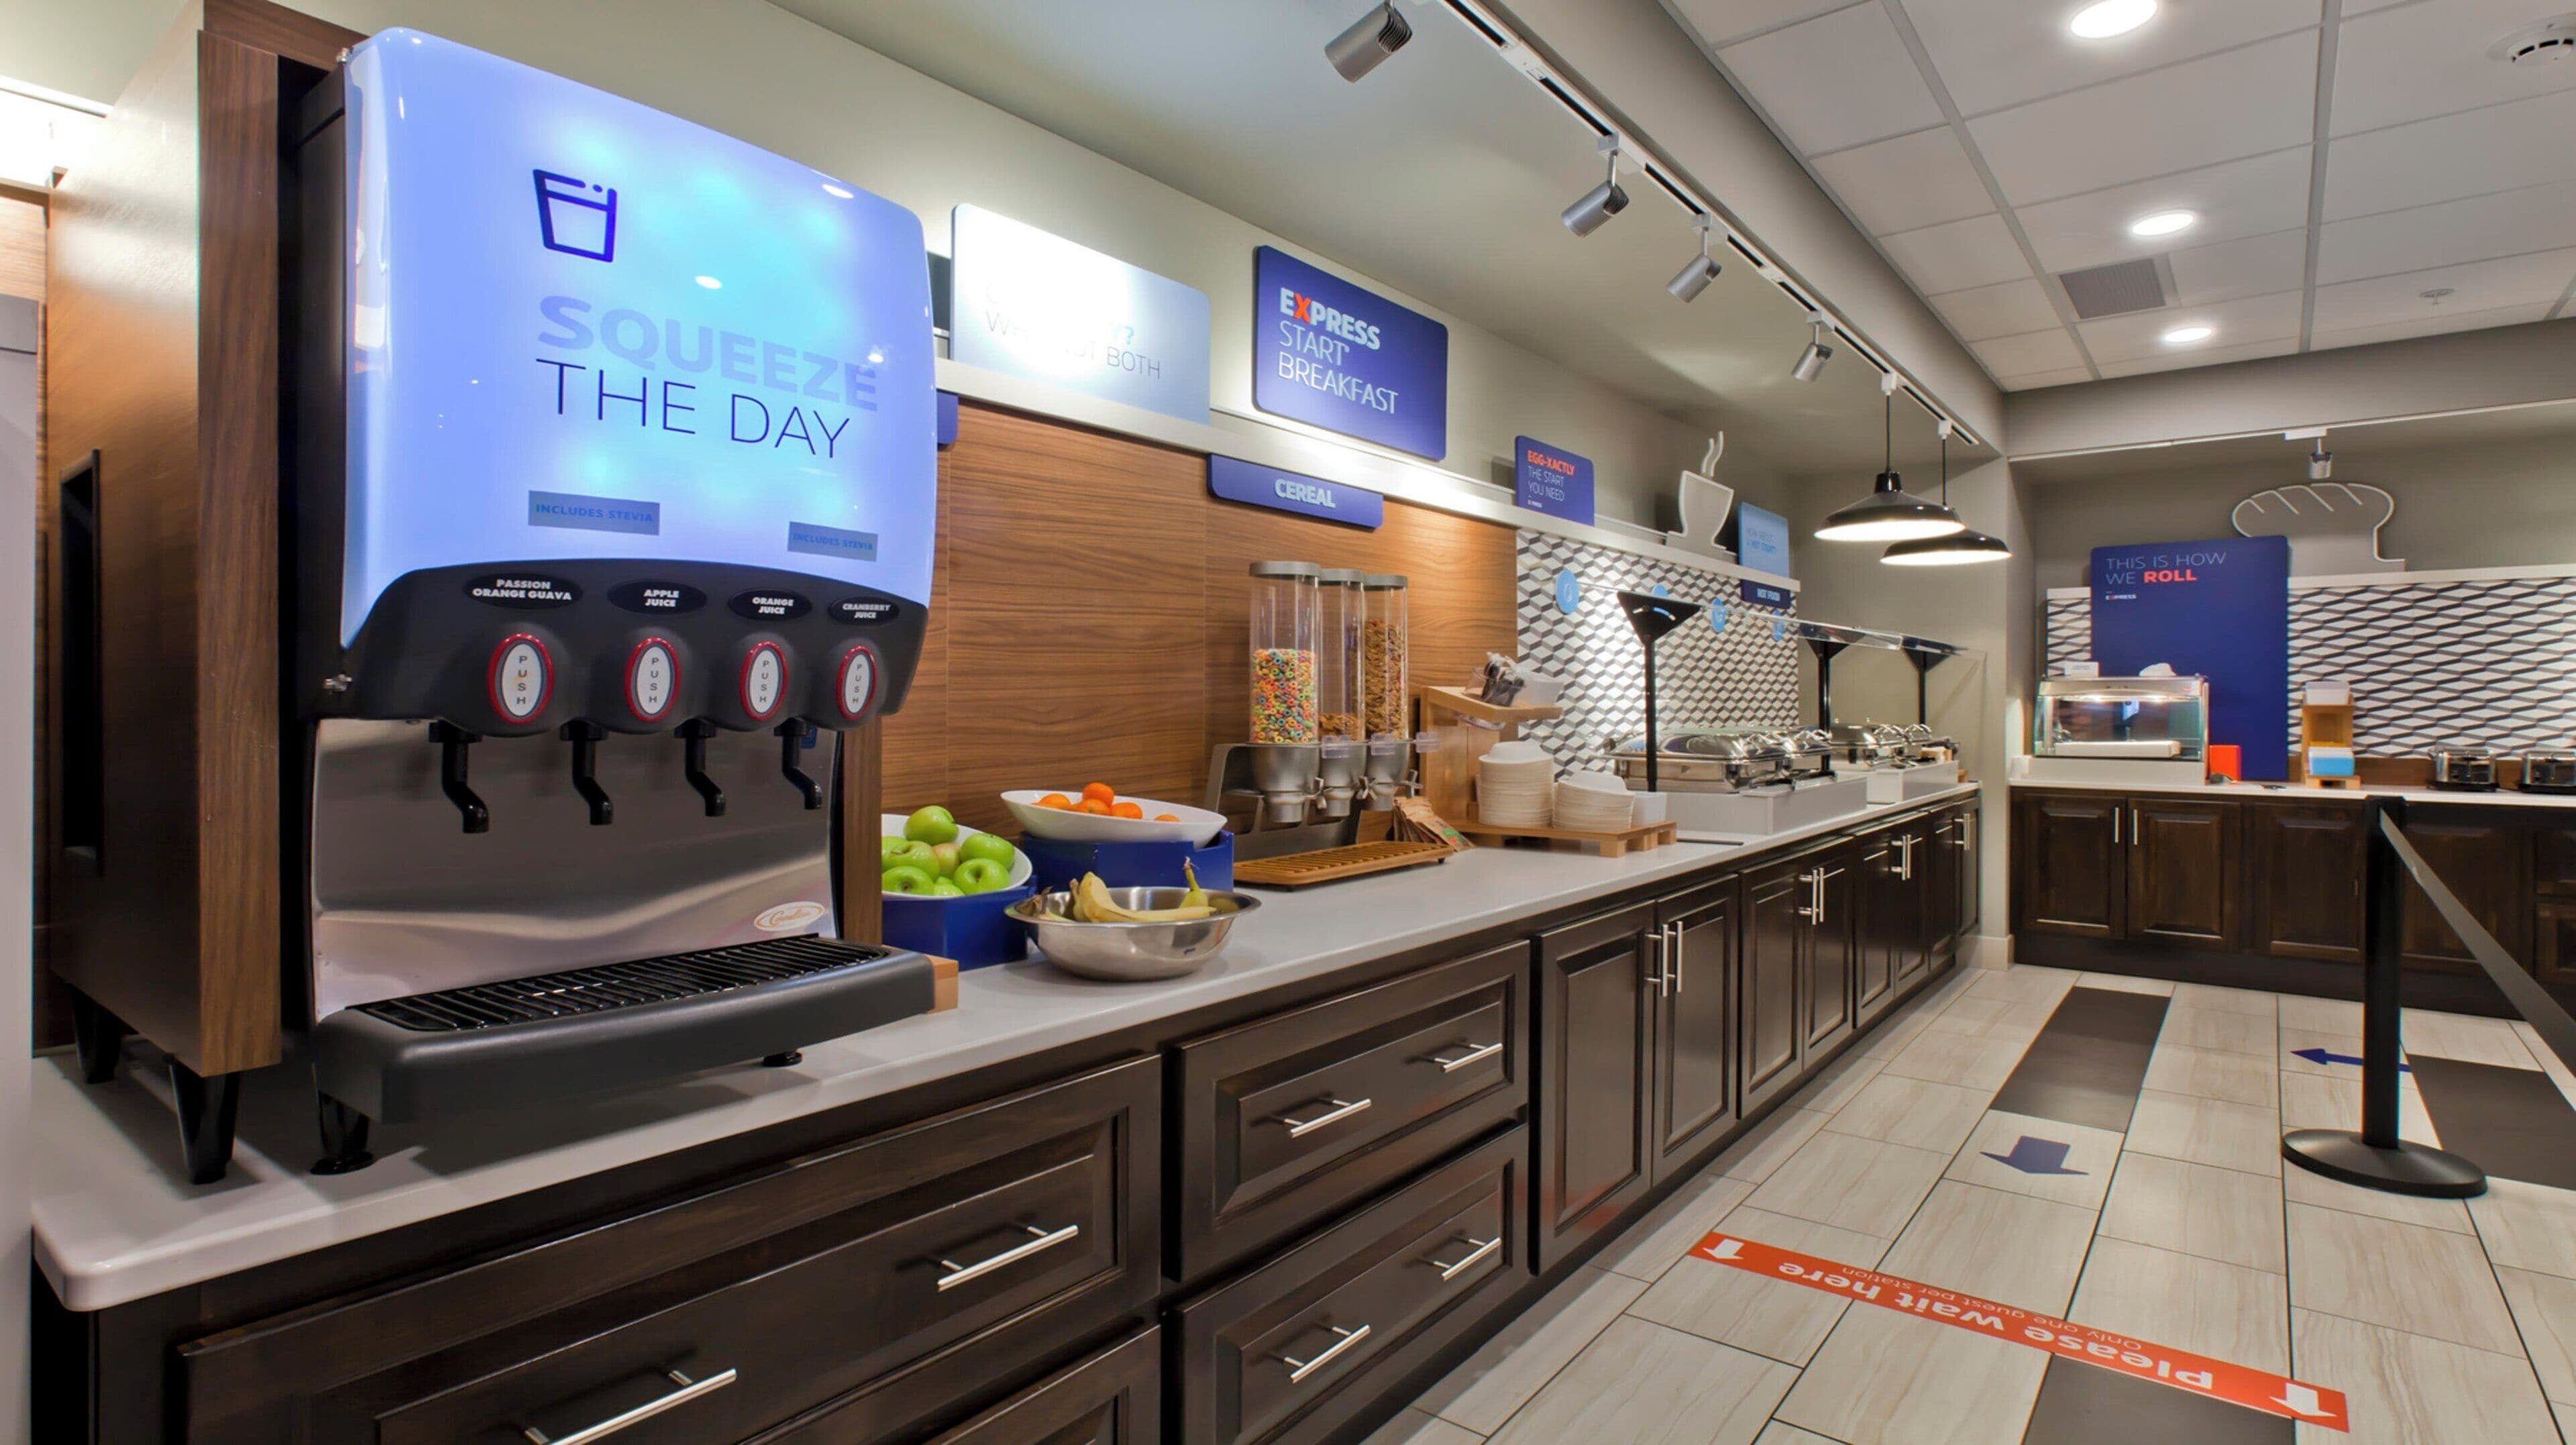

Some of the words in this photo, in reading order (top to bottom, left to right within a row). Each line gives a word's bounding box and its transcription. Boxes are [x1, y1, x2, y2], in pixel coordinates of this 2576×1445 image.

[1280, 287, 1381, 350] EXPRESS
[538, 295, 877, 411] SQUEEZE
[1108, 346, 1160, 379] BOTH
[1279, 352, 1399, 414] BREAKFAST
[536, 358, 696, 434] THE
[731, 393, 849, 458] DAY
[1527, 450, 1575, 476] EGG-XACTLY
[1528, 466, 1542, 481] THE
[1544, 471, 1564, 488] START
[1275, 478, 1336, 509] CEREAL
[1528, 481, 1544, 496] YOU
[1546, 486, 1565, 502] NEED
[536, 504, 603, 518] INCLUDES
[608, 510, 653, 522] STEVIA
[792, 533, 839, 546] INCLUDES
[843, 539, 873, 550] STEVIA
[2106, 556, 2146, 570] THIS
[2153, 555, 2169, 568] IS
[2176, 552, 2226, 567] HOW
[496, 579, 551, 590] PASSION
[2105, 572, 2136, 585] WE
[2143, 570, 2198, 583] ROLL
[472, 588, 525, 598] ORANGE
[528, 590, 572, 600] GUAVA
[643, 589, 680, 598] APPLE
[645, 598, 676, 607] JUICE
[752, 596, 794, 606] ORANGE
[758, 606, 785, 614] JUICE
[843, 603, 891, 612] CRANBERRY
[516, 655, 527, 704] PUSH
[649, 657, 659, 703] PUSH
[759, 660, 769, 702] PUSH
[853, 663, 862, 703] PUSH
[1778, 1263, 1881, 1299] here
[1842, 1267, 1912, 1289] station
[1921, 1287, 1955, 1301] per
[1894, 1293, 2004, 1331] wait
[1962, 1297, 2025, 1320] guest
[2033, 1316, 2078, 1333] one
[2087, 1330, 2142, 1351] Only
[2025, 1326, 2212, 1390] Please
